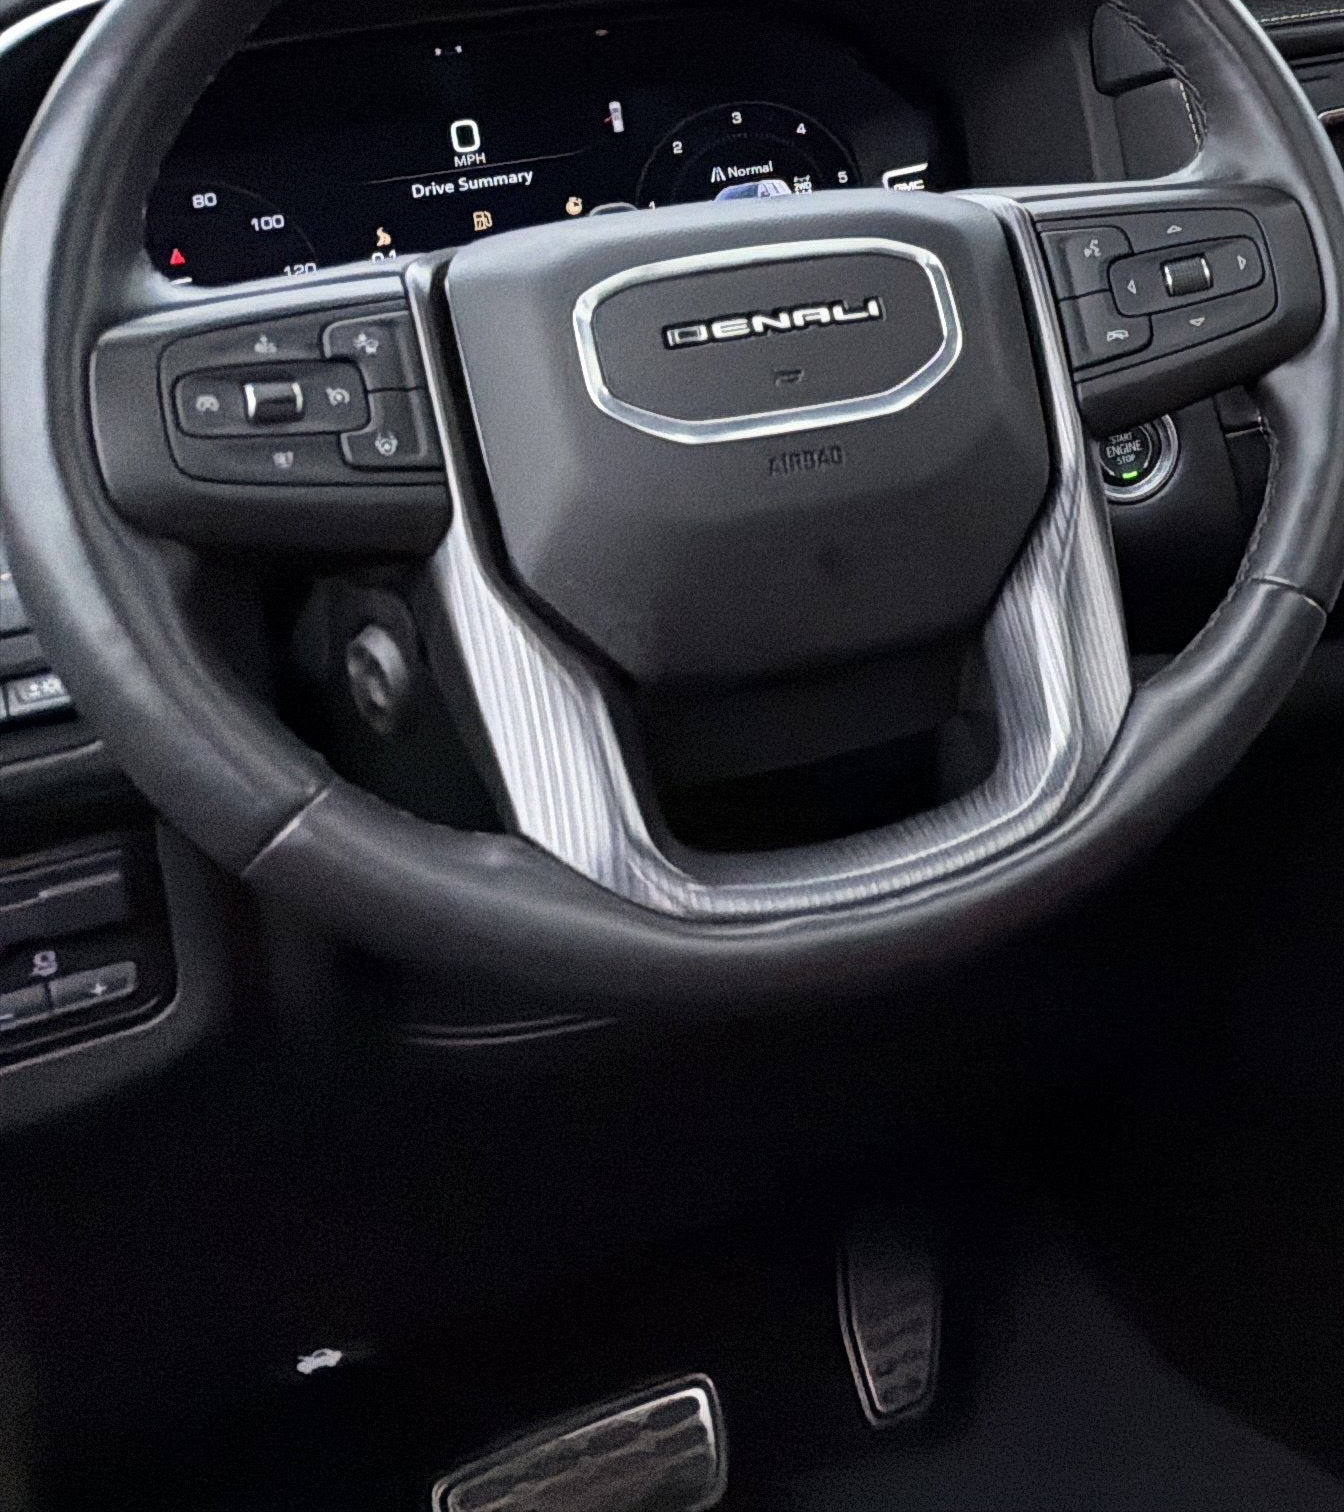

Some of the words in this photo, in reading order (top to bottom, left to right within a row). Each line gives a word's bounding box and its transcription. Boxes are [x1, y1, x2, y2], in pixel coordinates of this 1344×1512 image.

[732, 112, 742, 124] 3
[450, 119, 481, 153] 0
[796, 123, 807, 135] 4
[672, 141, 683, 154] 2
[454, 152, 486, 168] MPH
[727, 160, 774, 179] Normal
[838, 170, 849, 184] 5
[411, 181, 455, 199] Drive
[459, 170, 533, 191] Summary
[192, 193, 218, 209] 80
[250, 215, 285, 232] 100
[666, 298, 881, 347] DENALI
[1111, 431, 1133, 445] START
[1105, 439, 1142, 459] ENGINE
[1116, 453, 1136, 466] STOP
